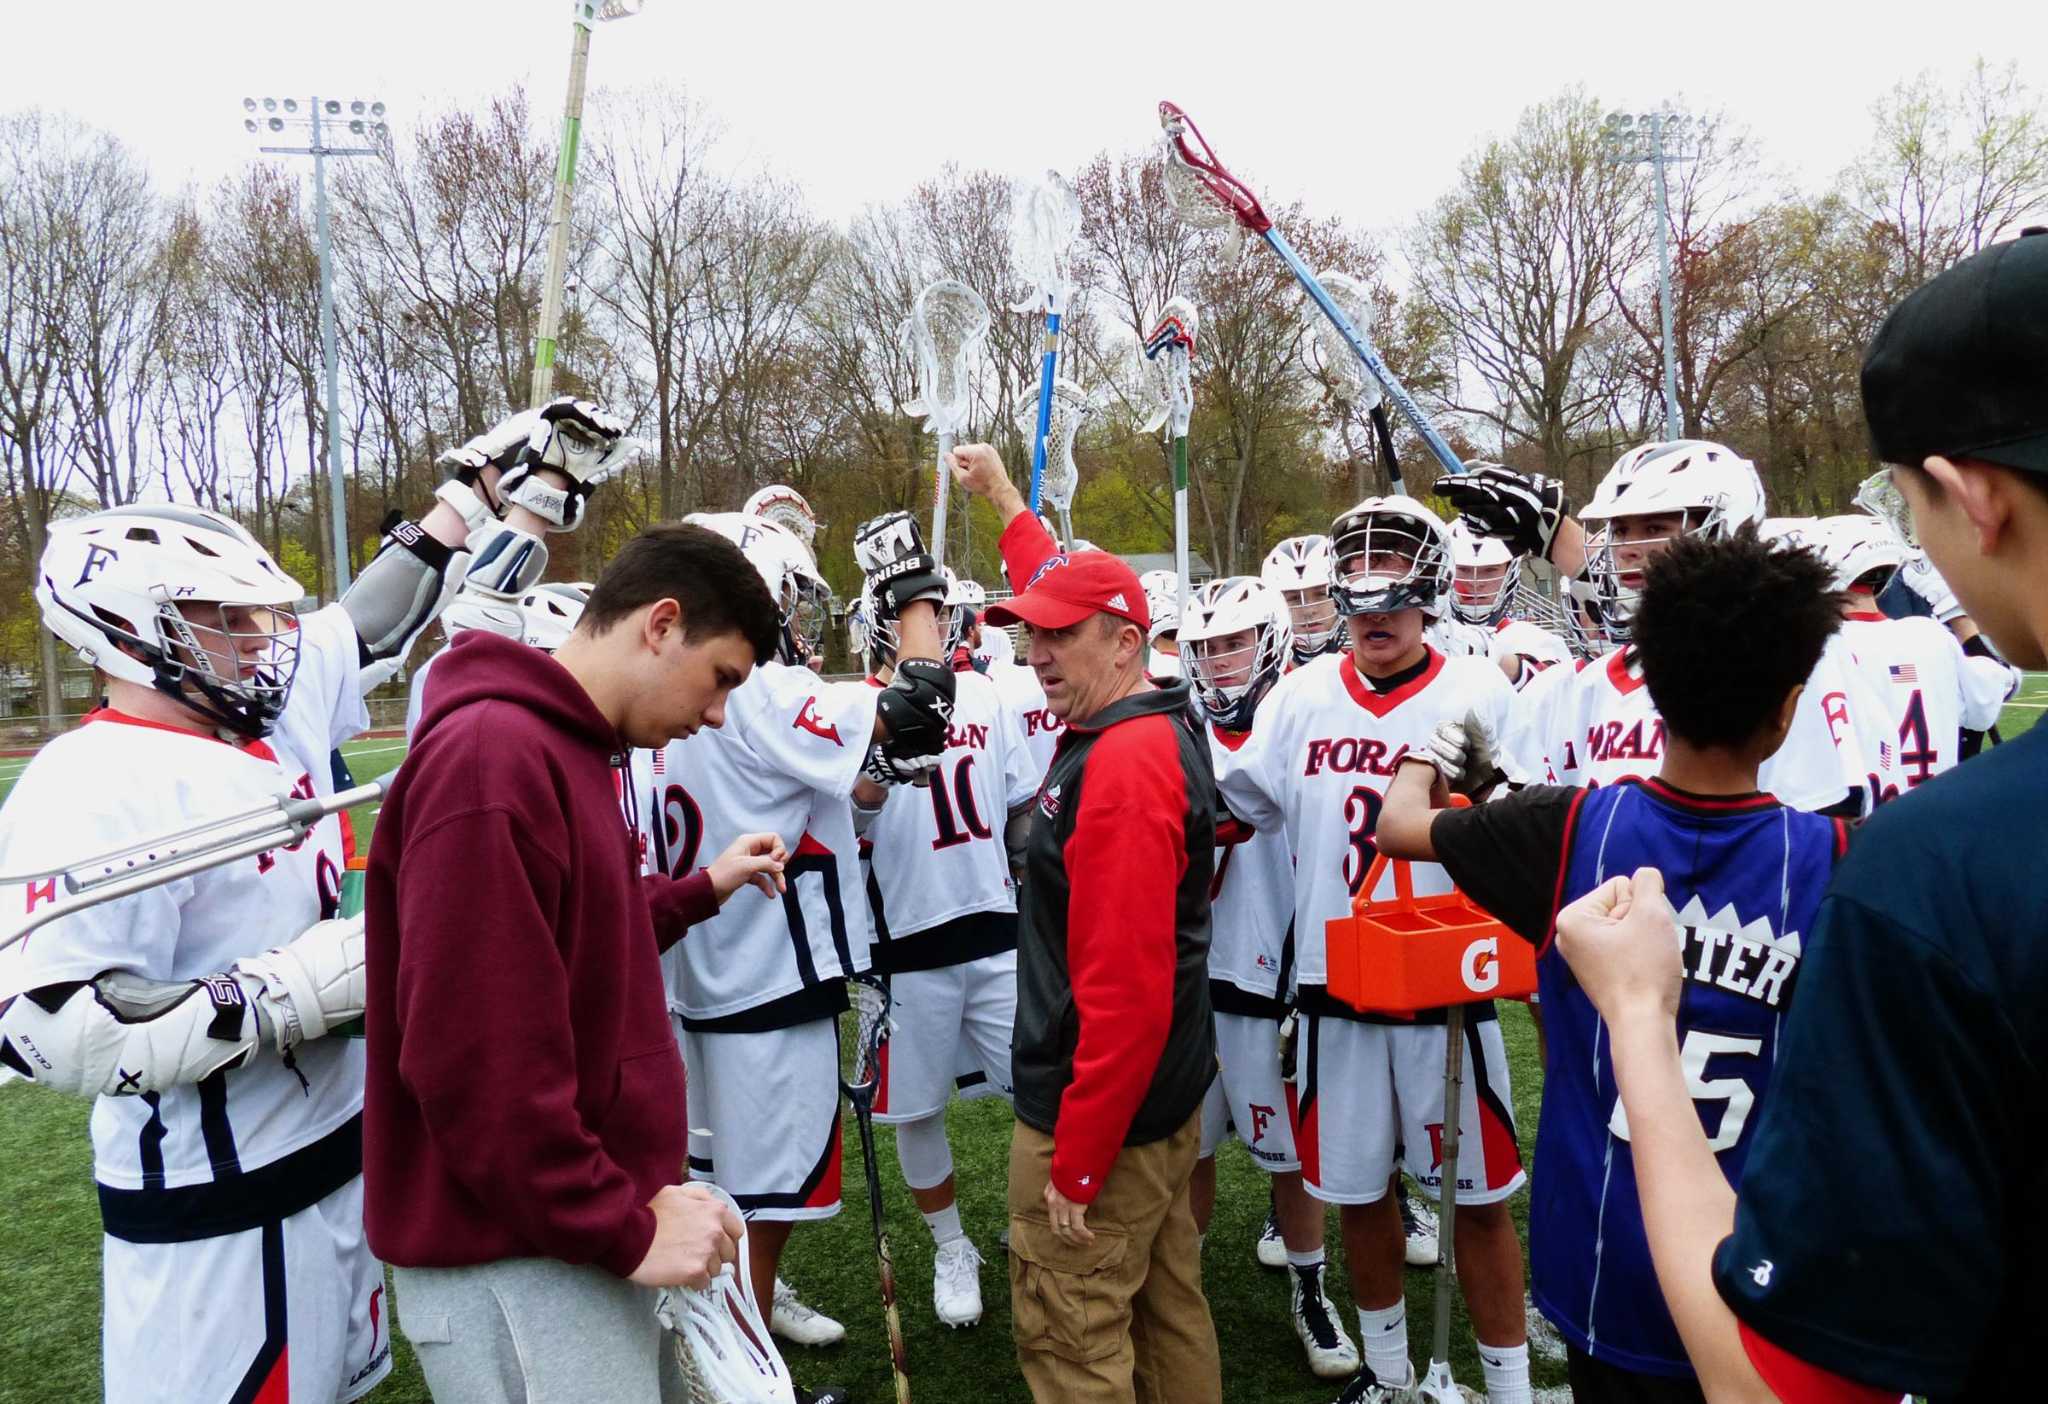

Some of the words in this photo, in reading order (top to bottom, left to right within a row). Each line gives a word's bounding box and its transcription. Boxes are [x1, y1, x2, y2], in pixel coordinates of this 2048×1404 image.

[740, 524, 764, 549] F
[73, 542, 119, 589] F
[792, 695, 844, 747] F
[1821, 691, 1849, 751] F
[1898, 689, 1938, 788] 4
[1304, 737, 1410, 777] FORA
[1461, 936, 1499, 993] G
[1681, 925, 1797, 1006] TER
[1249, 1102, 1276, 1145] F
